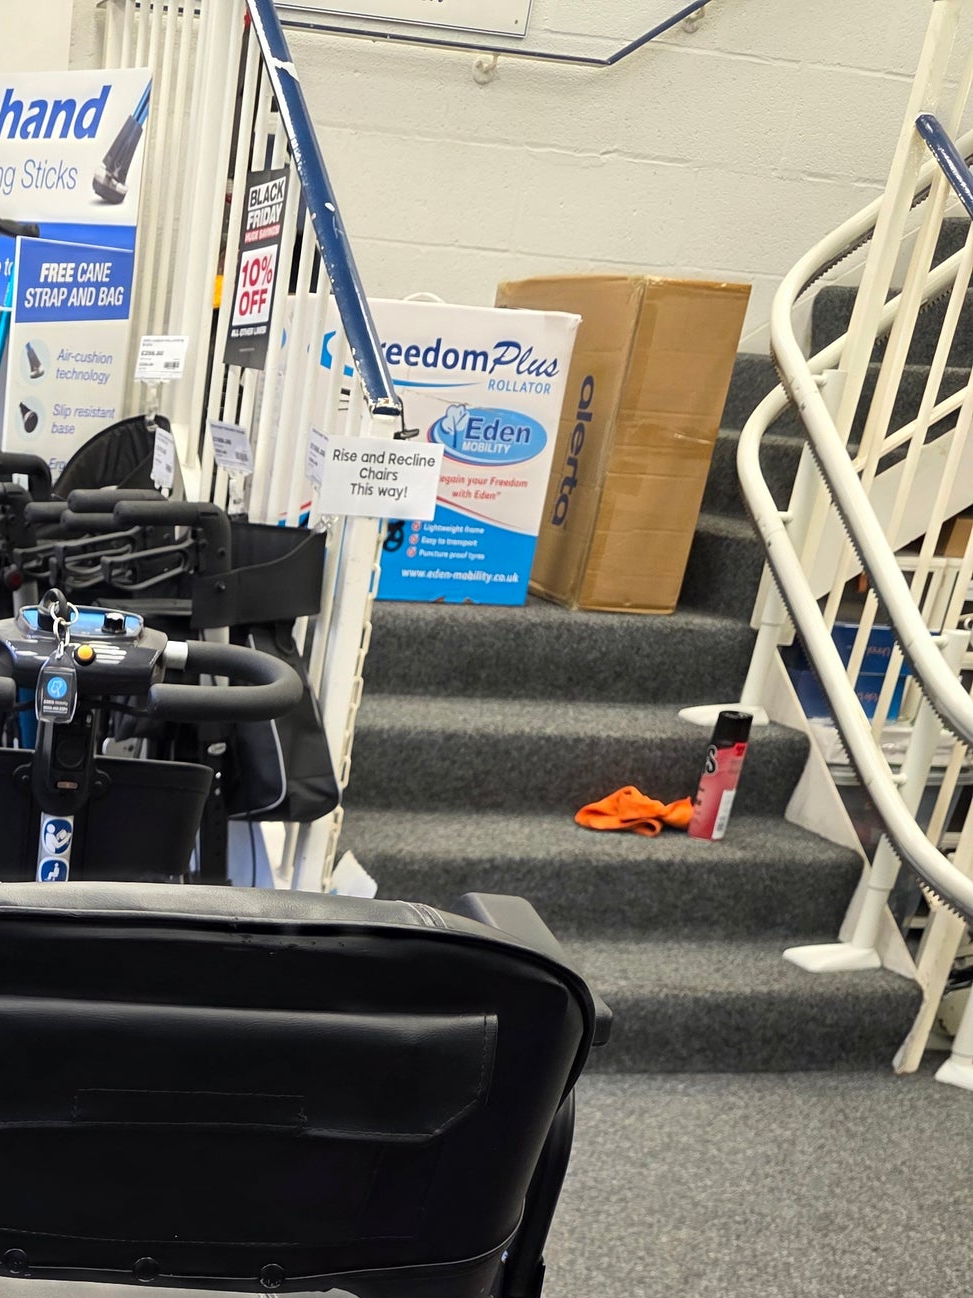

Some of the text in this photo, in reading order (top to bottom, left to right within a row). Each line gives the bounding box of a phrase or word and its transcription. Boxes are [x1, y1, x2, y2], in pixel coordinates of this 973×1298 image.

[21, 158, 78, 190] Sticks
[250, 180, 285, 208] BLACK
[246, 203, 283, 230] FRIDAY
[39, 262, 113, 283] FREE CANE
[242, 254, 273, 288] 10%
[24, 286, 125, 308] STRAP AND BAG
[238, 288, 269, 316] OFF
[56, 347, 114, 365] Air-cushion
[55, 368, 111, 385] technology
[487, 379, 551, 395] ROLLATOR
[52, 403, 116, 419] Slip resistant
[50, 421, 75, 434] base
[464, 416, 531, 444] Eden
[461, 441, 512, 455] MOBILITY
[551, 375, 595, 526] alerta
[48, 457, 68, 473] Erg
[332, 448, 436, 467] Rise and Recline
[359, 467, 399, 481] Chairs
[440, 475, 529, 488] egain your Freedom
[350, 482, 409, 501] This way!
[452, 489, 471, 499] with
[423, 523, 485, 534] Lightweight frame
[421, 536, 437, 546] Easy
[446, 538, 479, 547] transport
[418, 549, 448, 558] Puncture
[449, 551, 468, 559] proof
[401, 568, 520, 584] www.eden-mobility.co.uk
